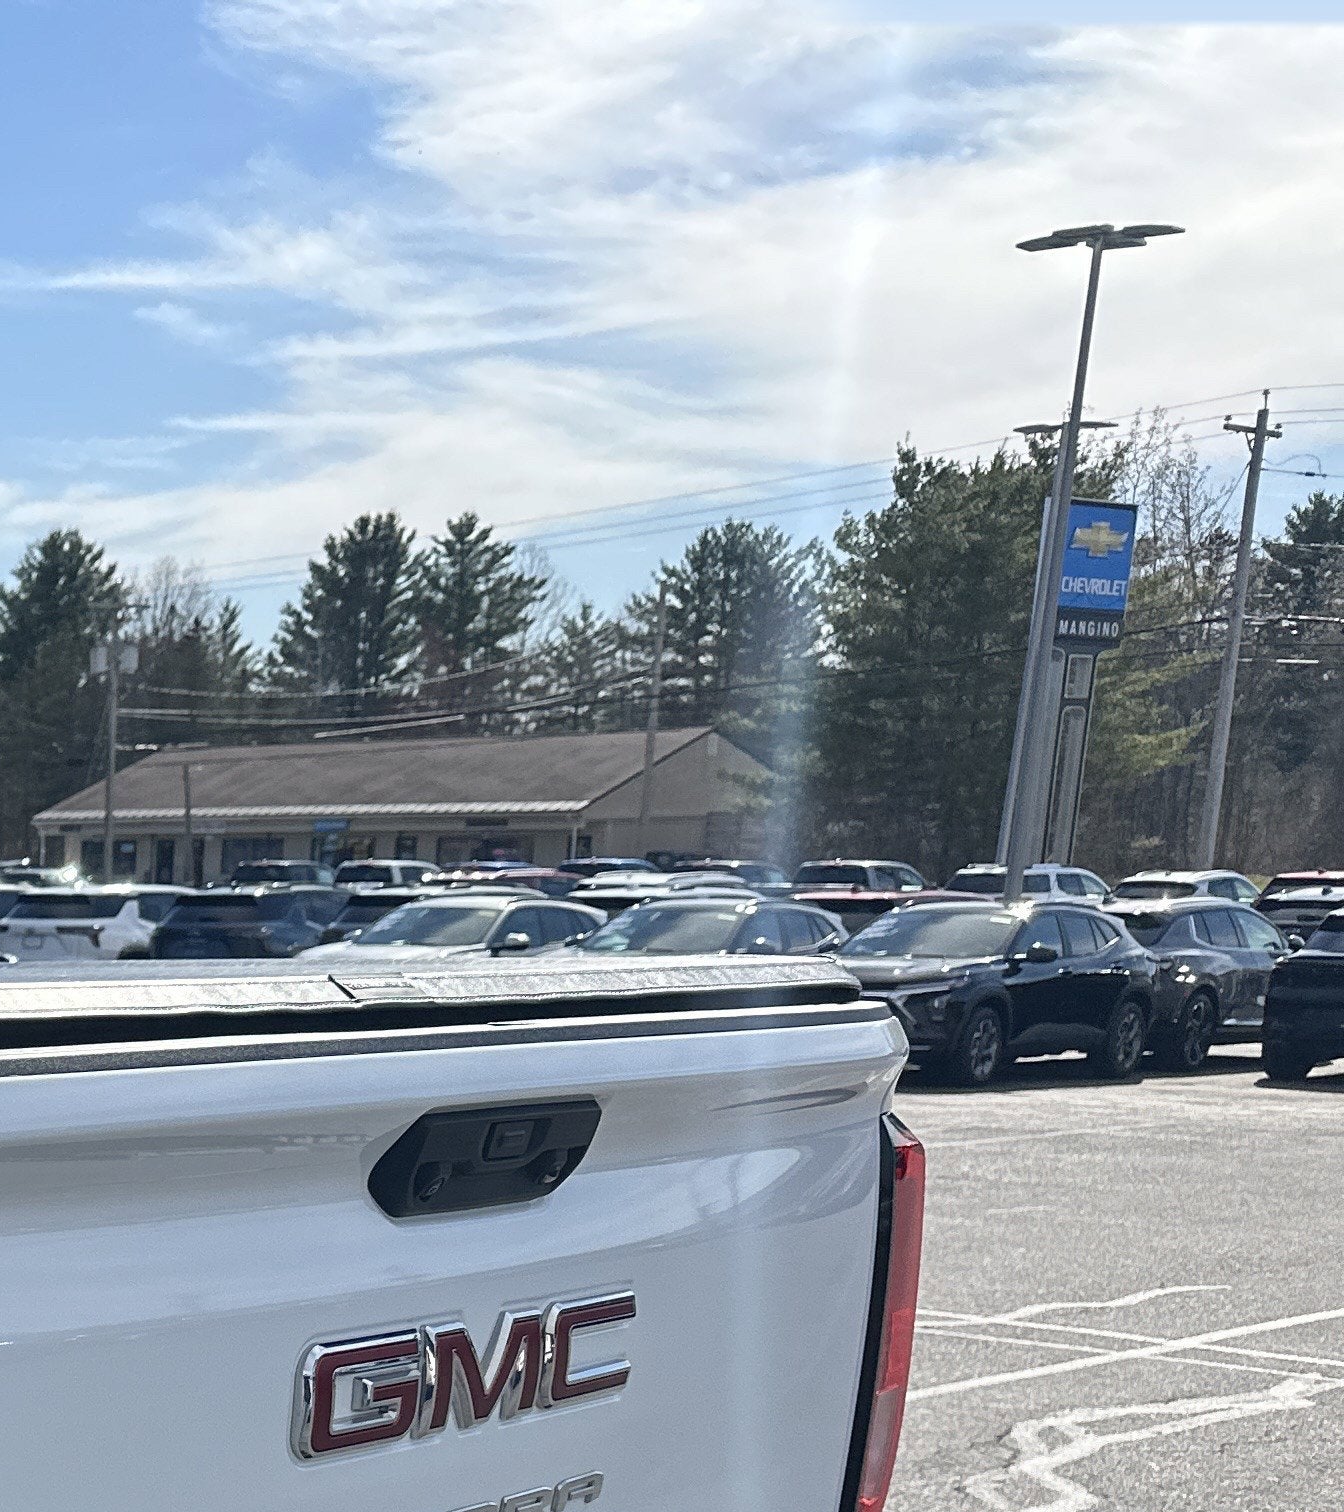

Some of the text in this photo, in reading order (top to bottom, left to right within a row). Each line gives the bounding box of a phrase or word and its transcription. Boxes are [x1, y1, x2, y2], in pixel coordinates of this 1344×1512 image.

[1061, 576, 1127, 596] CHEVROLET
[1058, 620, 1119, 637] MANGINO
[291, 1290, 636, 1461] GMC
